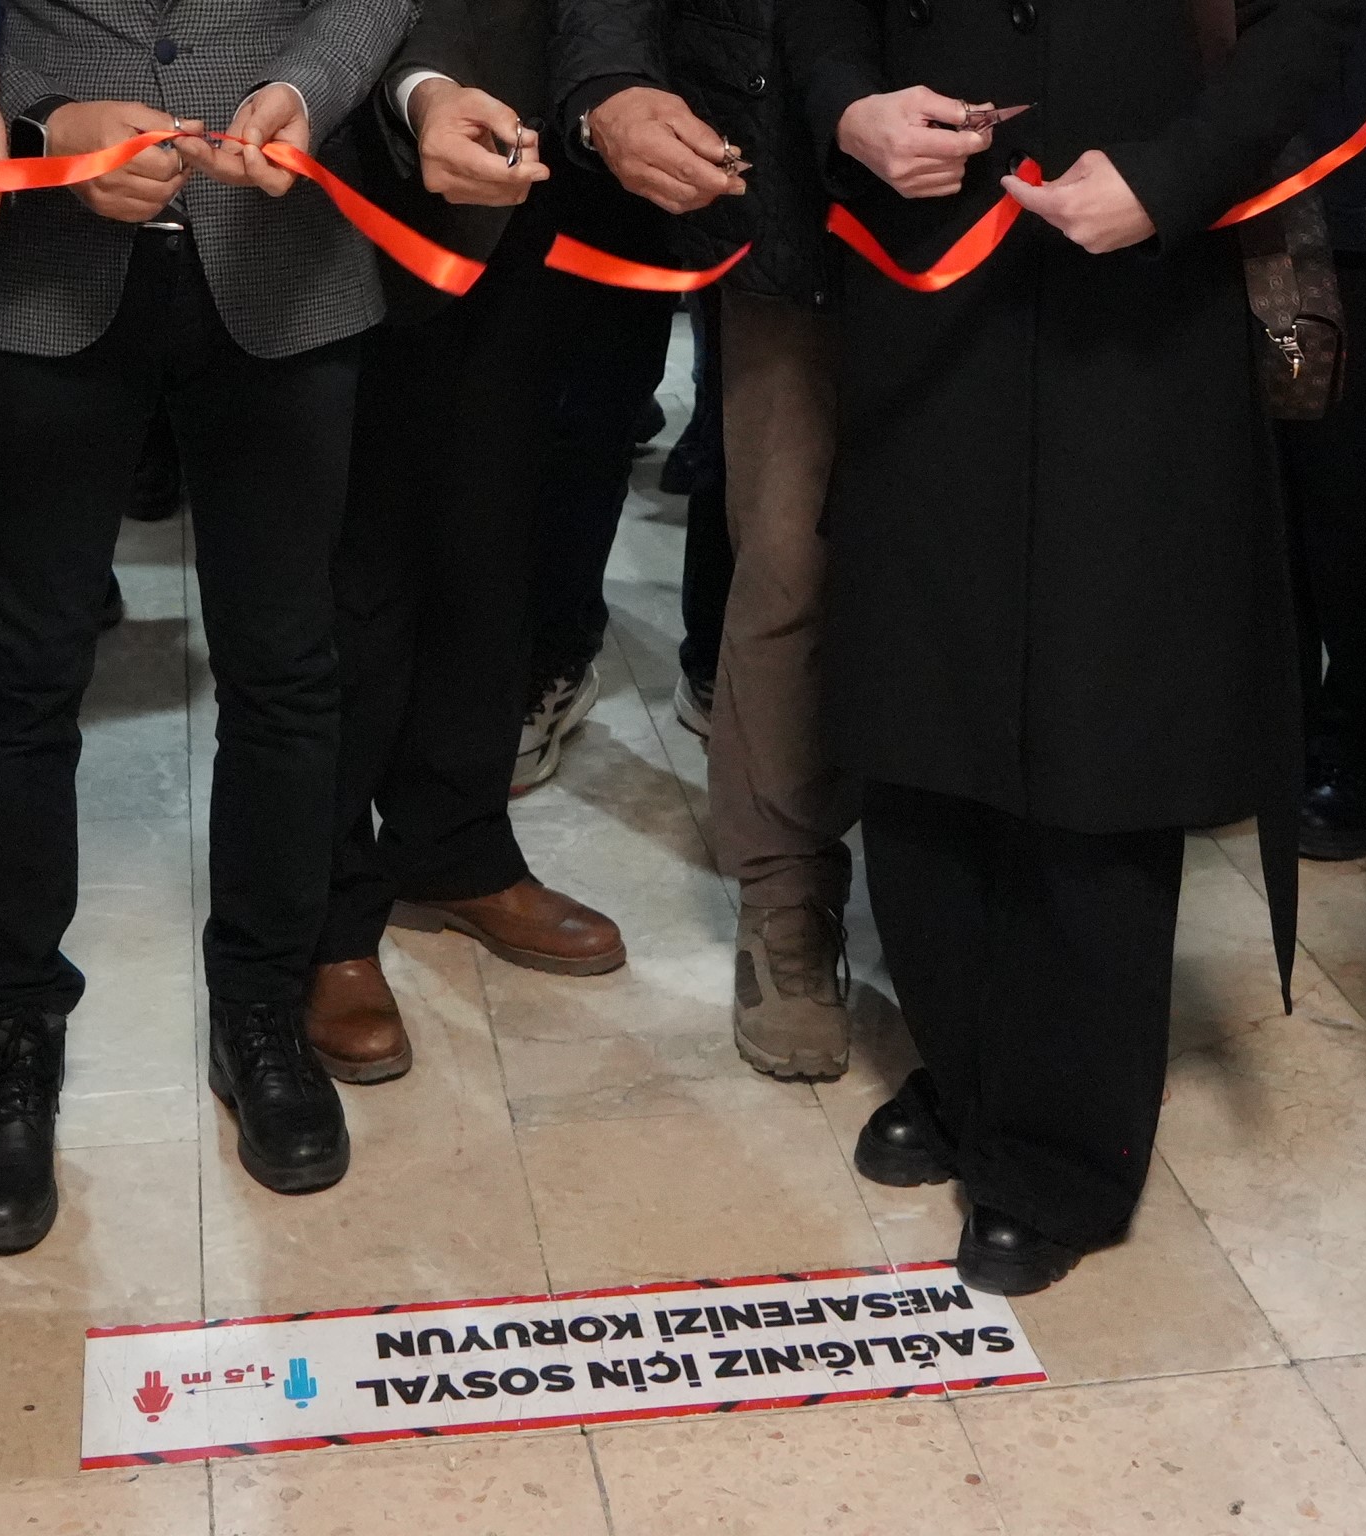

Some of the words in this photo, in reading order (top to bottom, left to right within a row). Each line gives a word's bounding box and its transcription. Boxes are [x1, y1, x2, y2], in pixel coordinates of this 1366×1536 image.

[654, 1283, 975, 1343] MESAFENİZİ
[375, 1312, 645, 1360] KORUYUN
[708, 1325, 1016, 1379] SAĞLIĞINIZ
[181, 1371, 212, 1385] m
[223, 1362, 276, 1384] 1,5
[355, 1363, 576, 1407] SOSYAL
[588, 1349, 702, 1392] İÇİN
